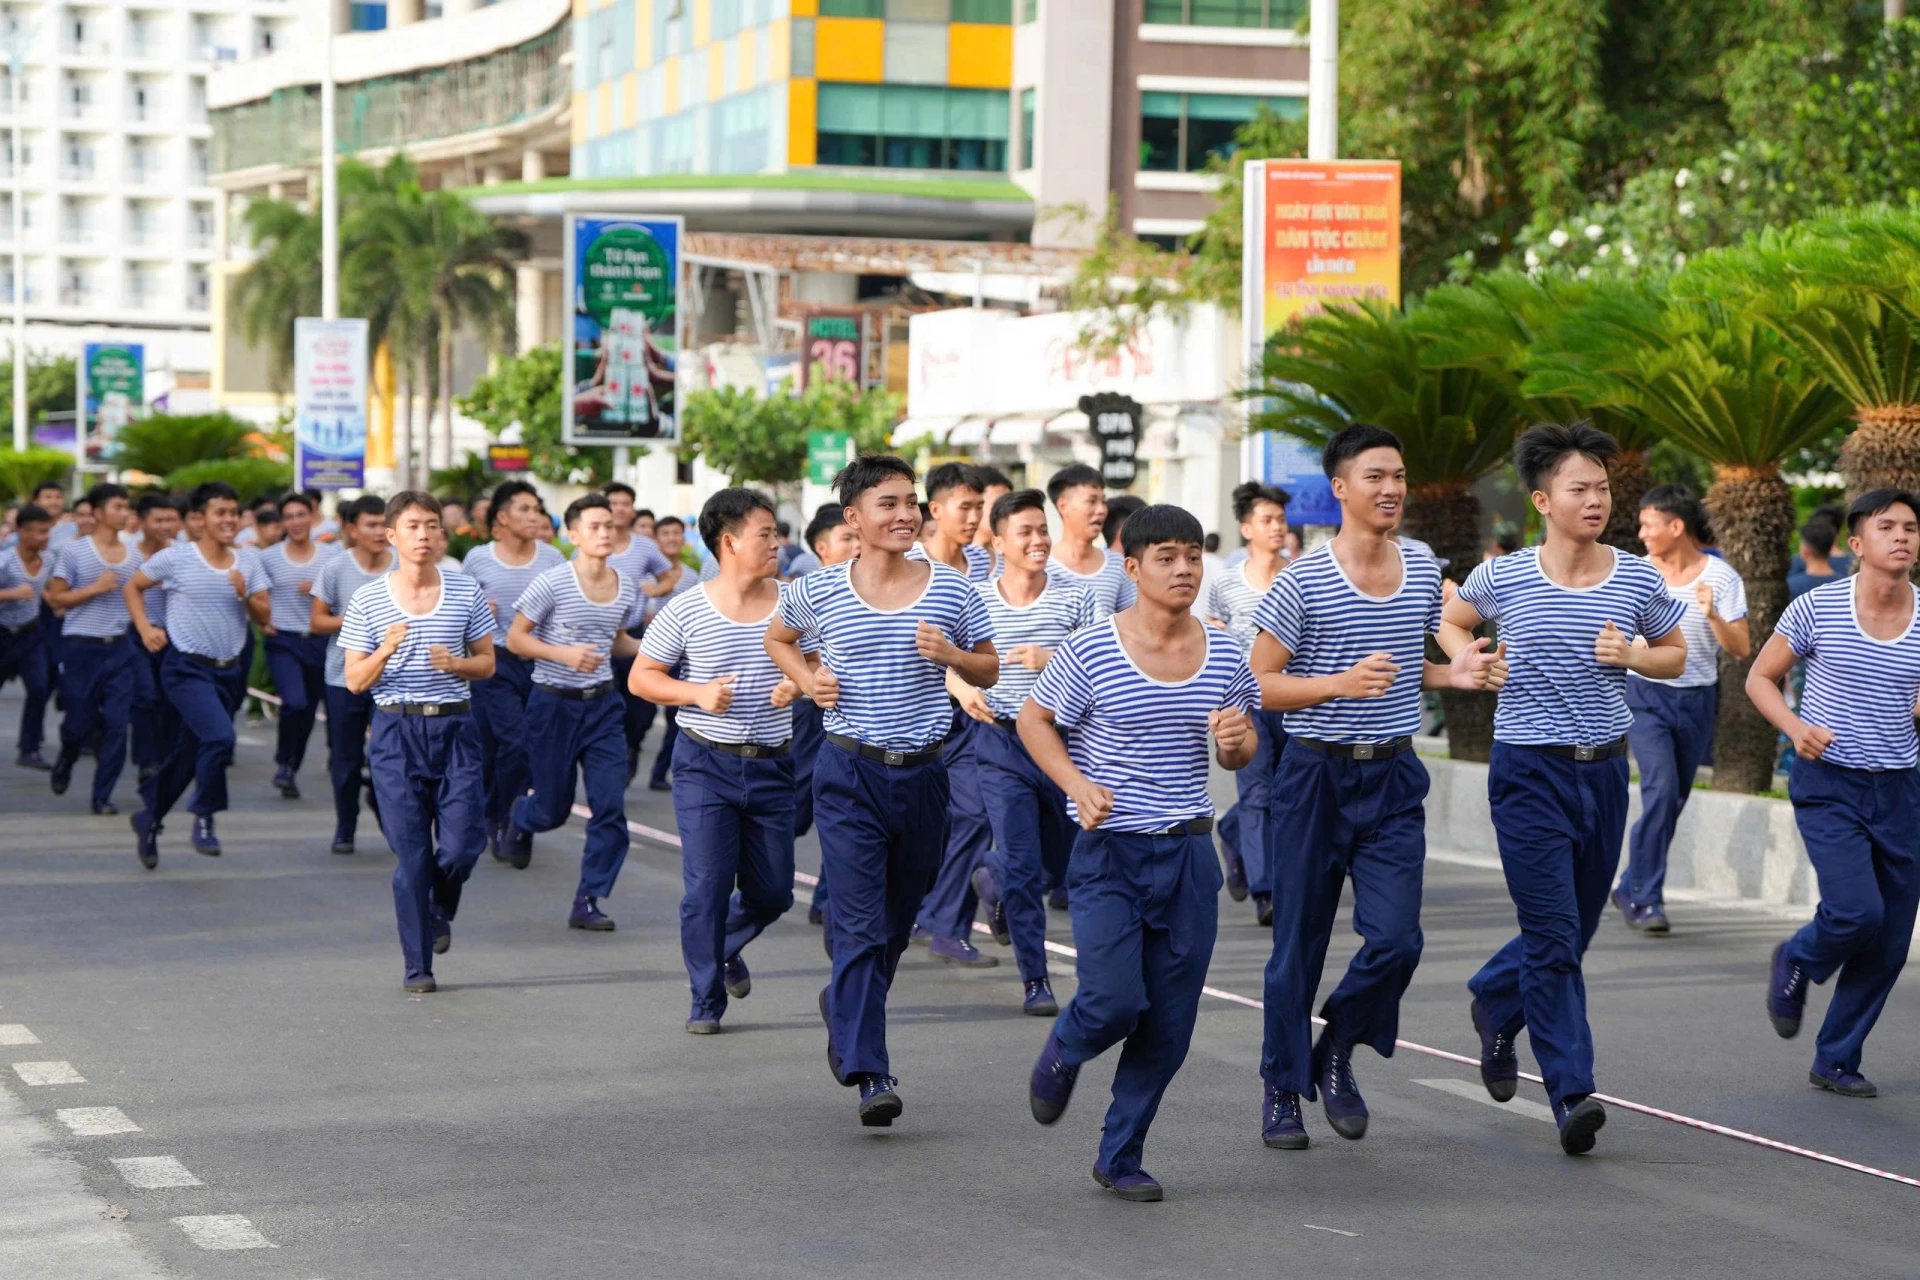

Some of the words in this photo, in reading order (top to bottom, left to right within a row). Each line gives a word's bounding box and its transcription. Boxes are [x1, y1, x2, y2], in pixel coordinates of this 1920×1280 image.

[1311, 226, 1341, 251] TỘC
[809, 316, 859, 341] HOTEL
[1097, 411, 1134, 434] SPA
